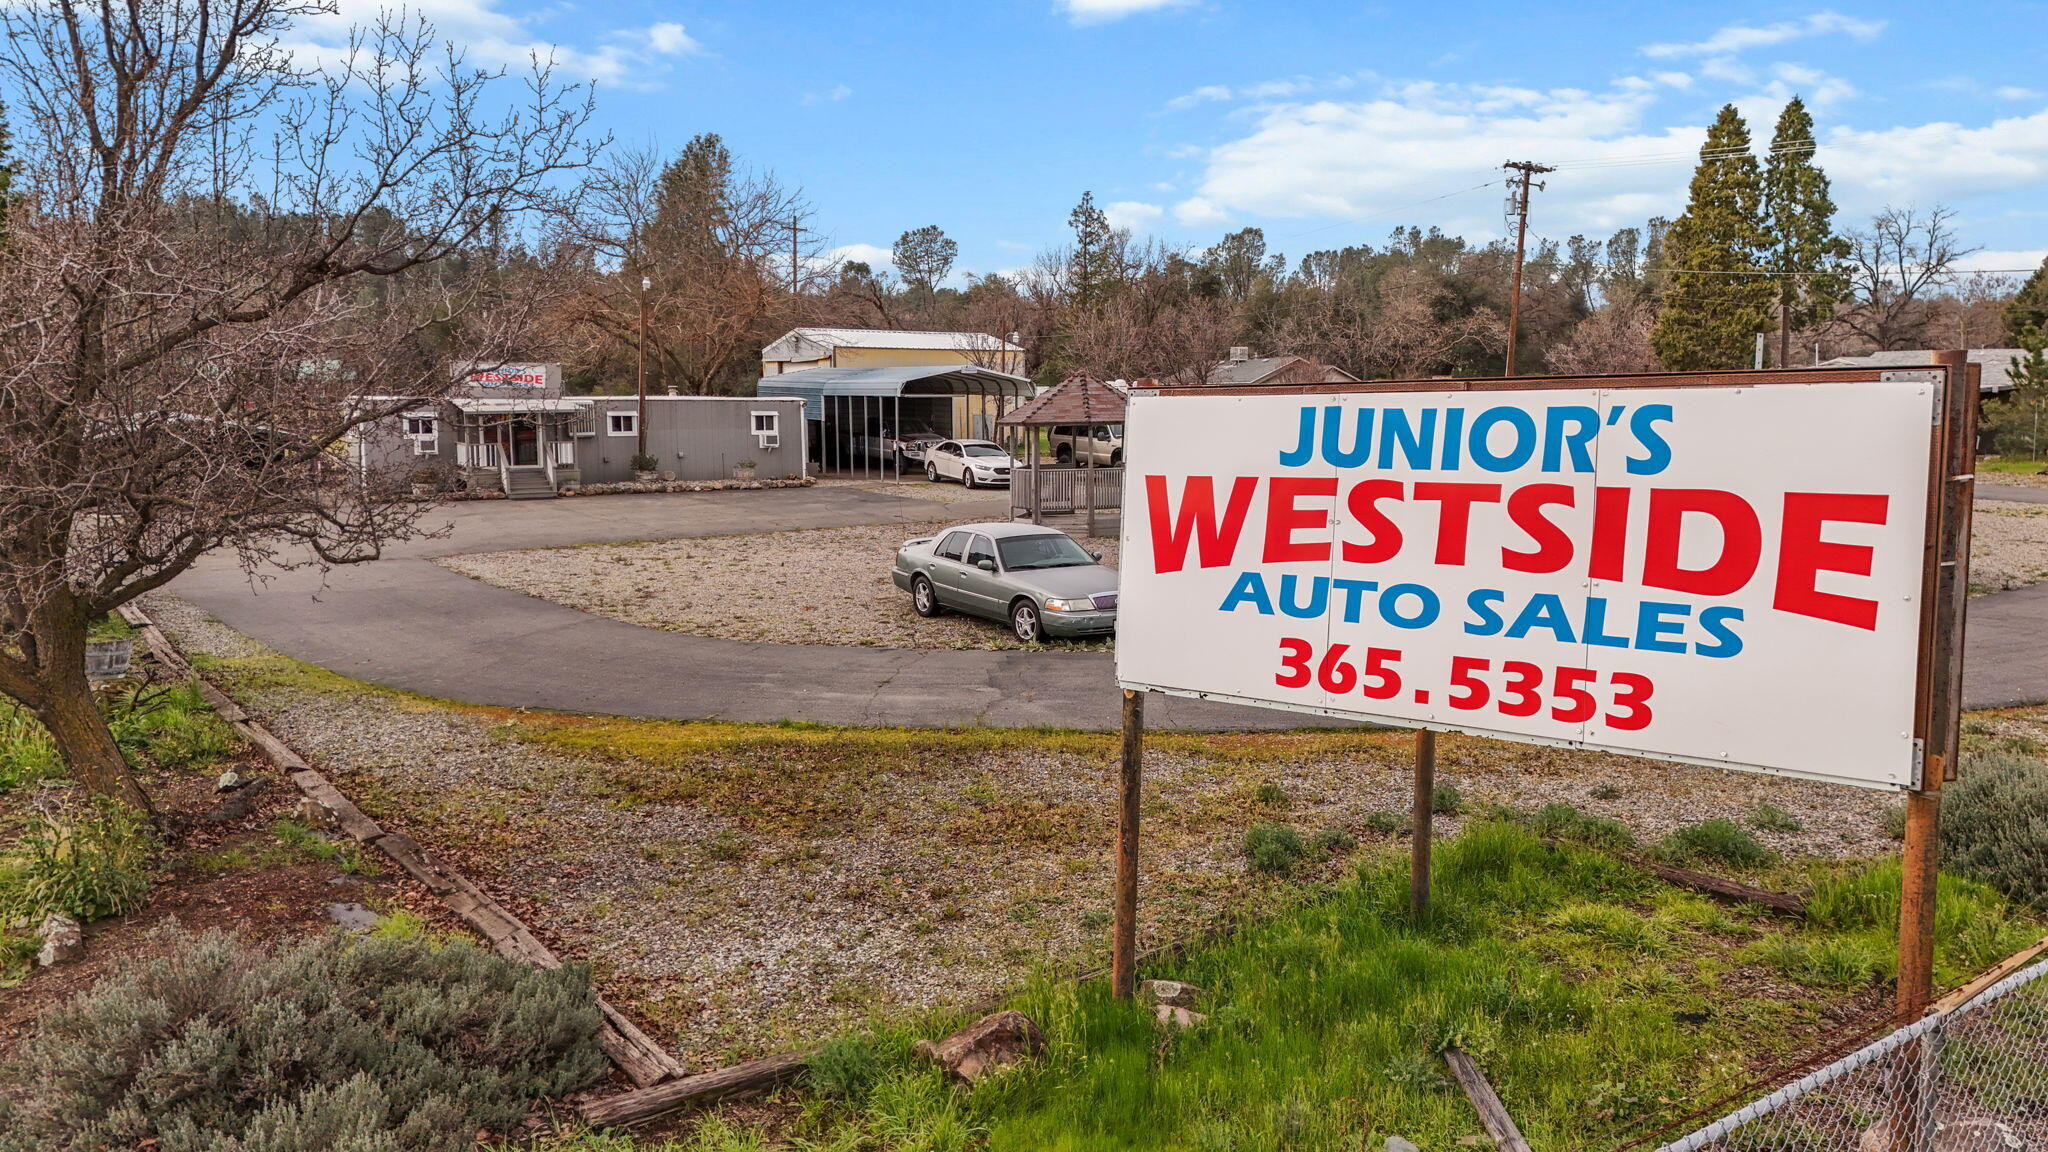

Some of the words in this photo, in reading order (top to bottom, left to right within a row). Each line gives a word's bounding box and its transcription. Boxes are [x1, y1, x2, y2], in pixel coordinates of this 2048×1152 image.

[470, 373, 543, 384] WESTSIDE
[1279, 404, 1673, 475] JUNIOR'S
[1145, 475, 1889, 631] WESTSIDE
[1219, 571, 1441, 630] AUTO
[1463, 588, 1745, 658] SALES
[1274, 637, 1654, 731] 365.5353
